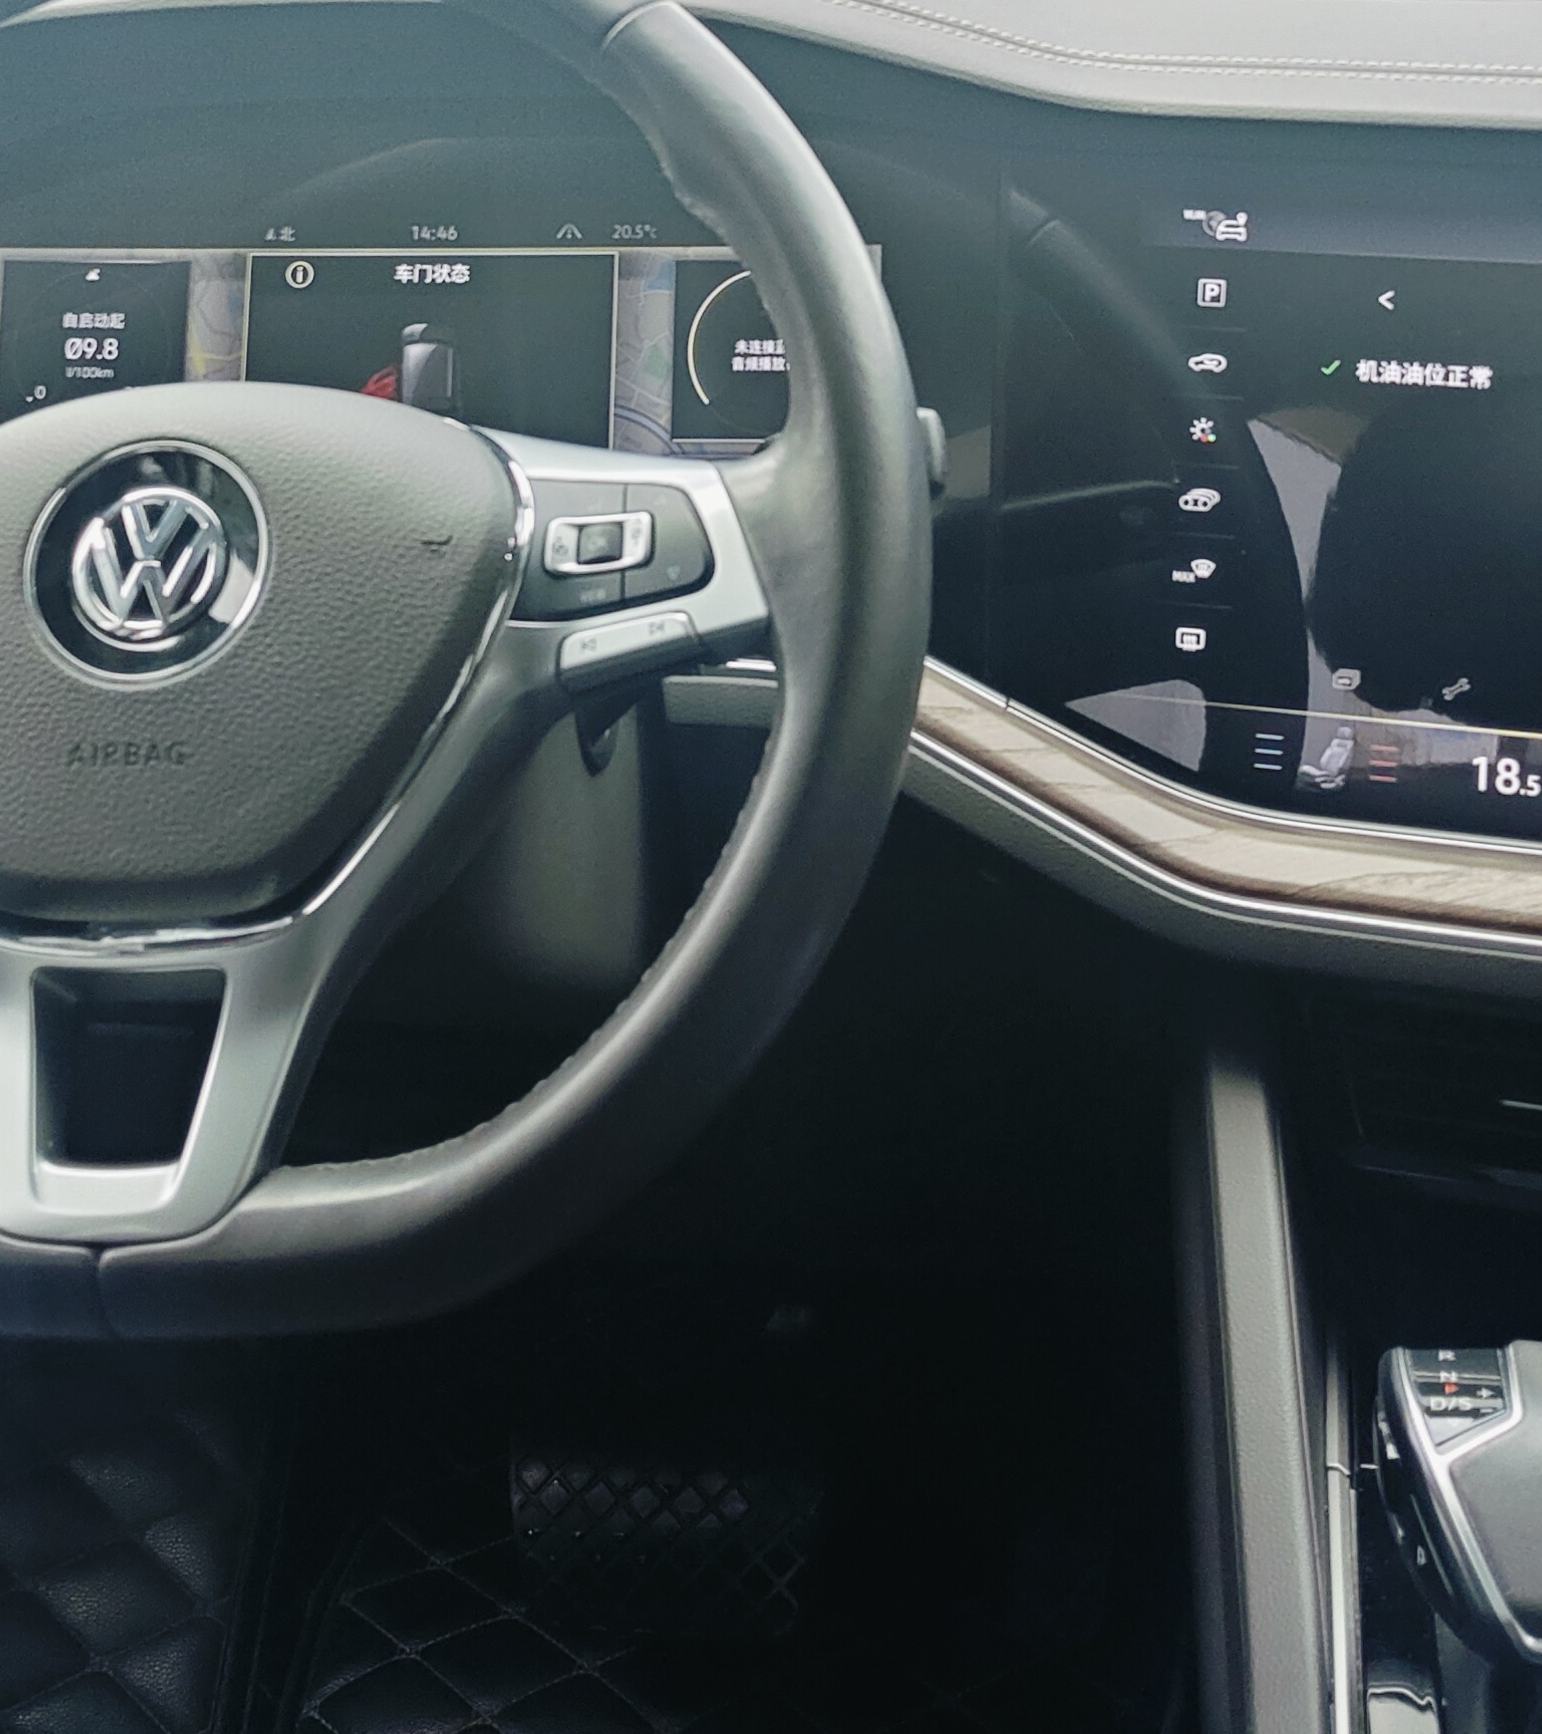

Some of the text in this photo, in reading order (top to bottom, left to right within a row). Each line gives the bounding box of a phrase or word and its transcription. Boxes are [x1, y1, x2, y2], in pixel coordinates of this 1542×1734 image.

[412, 225, 459, 241] 14:46
[394, 263, 471, 284] 车门状态
[1355, 359, 1494, 390] 机油油位正常
[64, 740, 197, 768] AIRBAG
[1438, 1349, 1457, 1362] R
[1430, 1397, 1473, 1412] D/S
